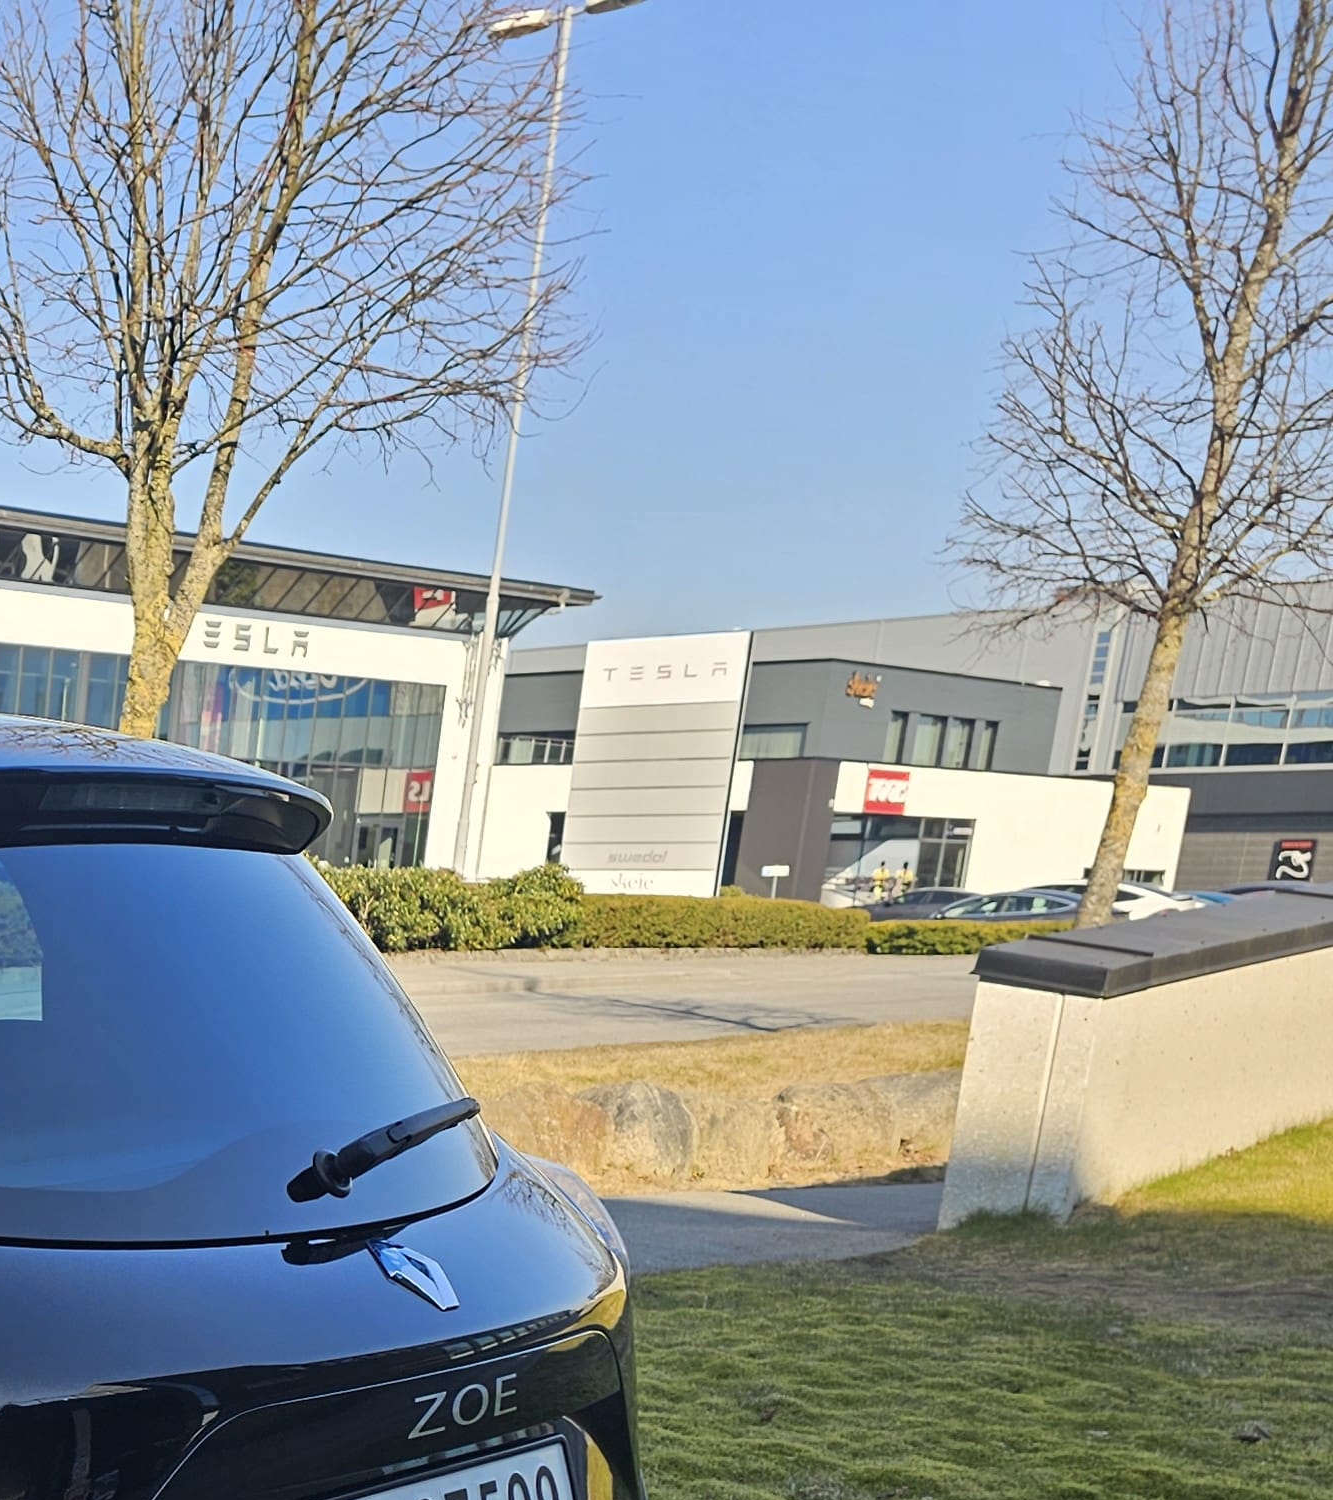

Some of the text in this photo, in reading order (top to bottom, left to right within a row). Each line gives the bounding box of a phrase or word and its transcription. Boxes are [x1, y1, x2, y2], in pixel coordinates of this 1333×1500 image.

[203, 620, 310, 657] ESLA
[603, 661, 728, 682] TESLA
[408, 1373, 518, 1440] ZOE
